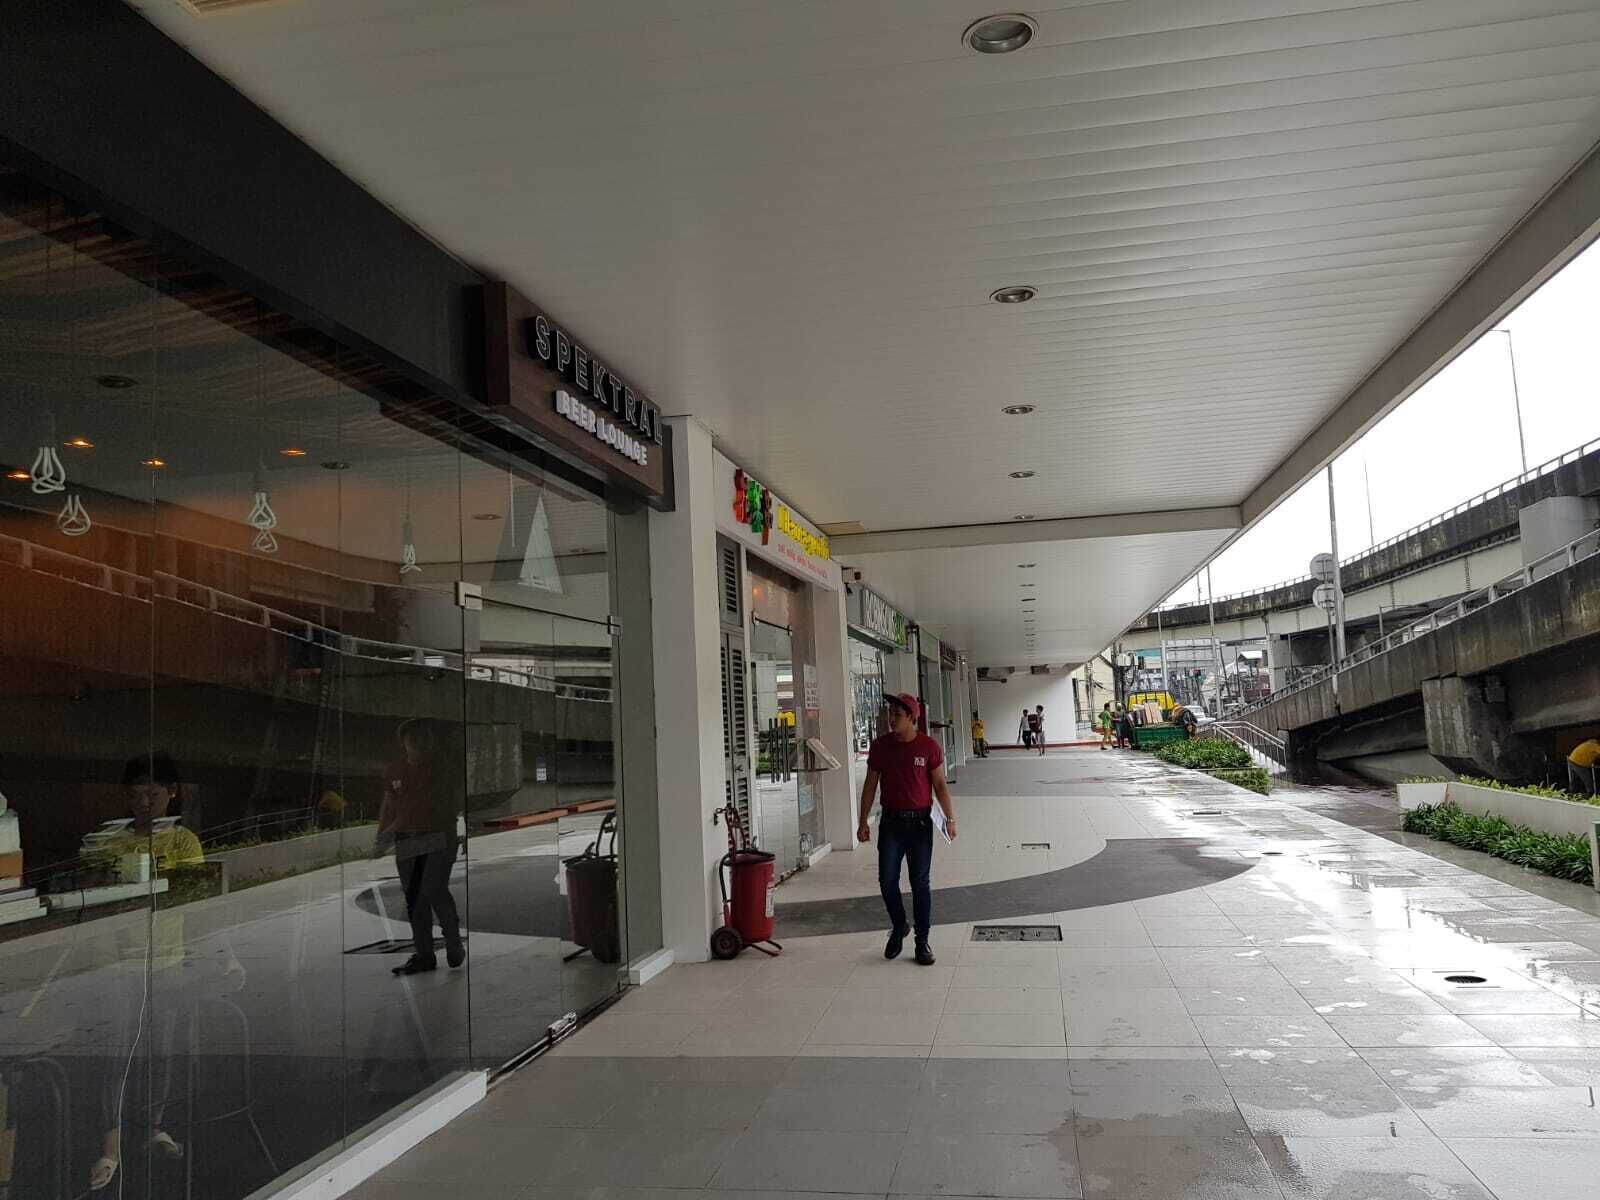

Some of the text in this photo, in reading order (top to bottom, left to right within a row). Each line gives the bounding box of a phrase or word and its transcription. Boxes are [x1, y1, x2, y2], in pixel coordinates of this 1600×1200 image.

[535, 315, 663, 446] SPEKTRAL
[555, 390, 648, 465] BEER LOUNGE
